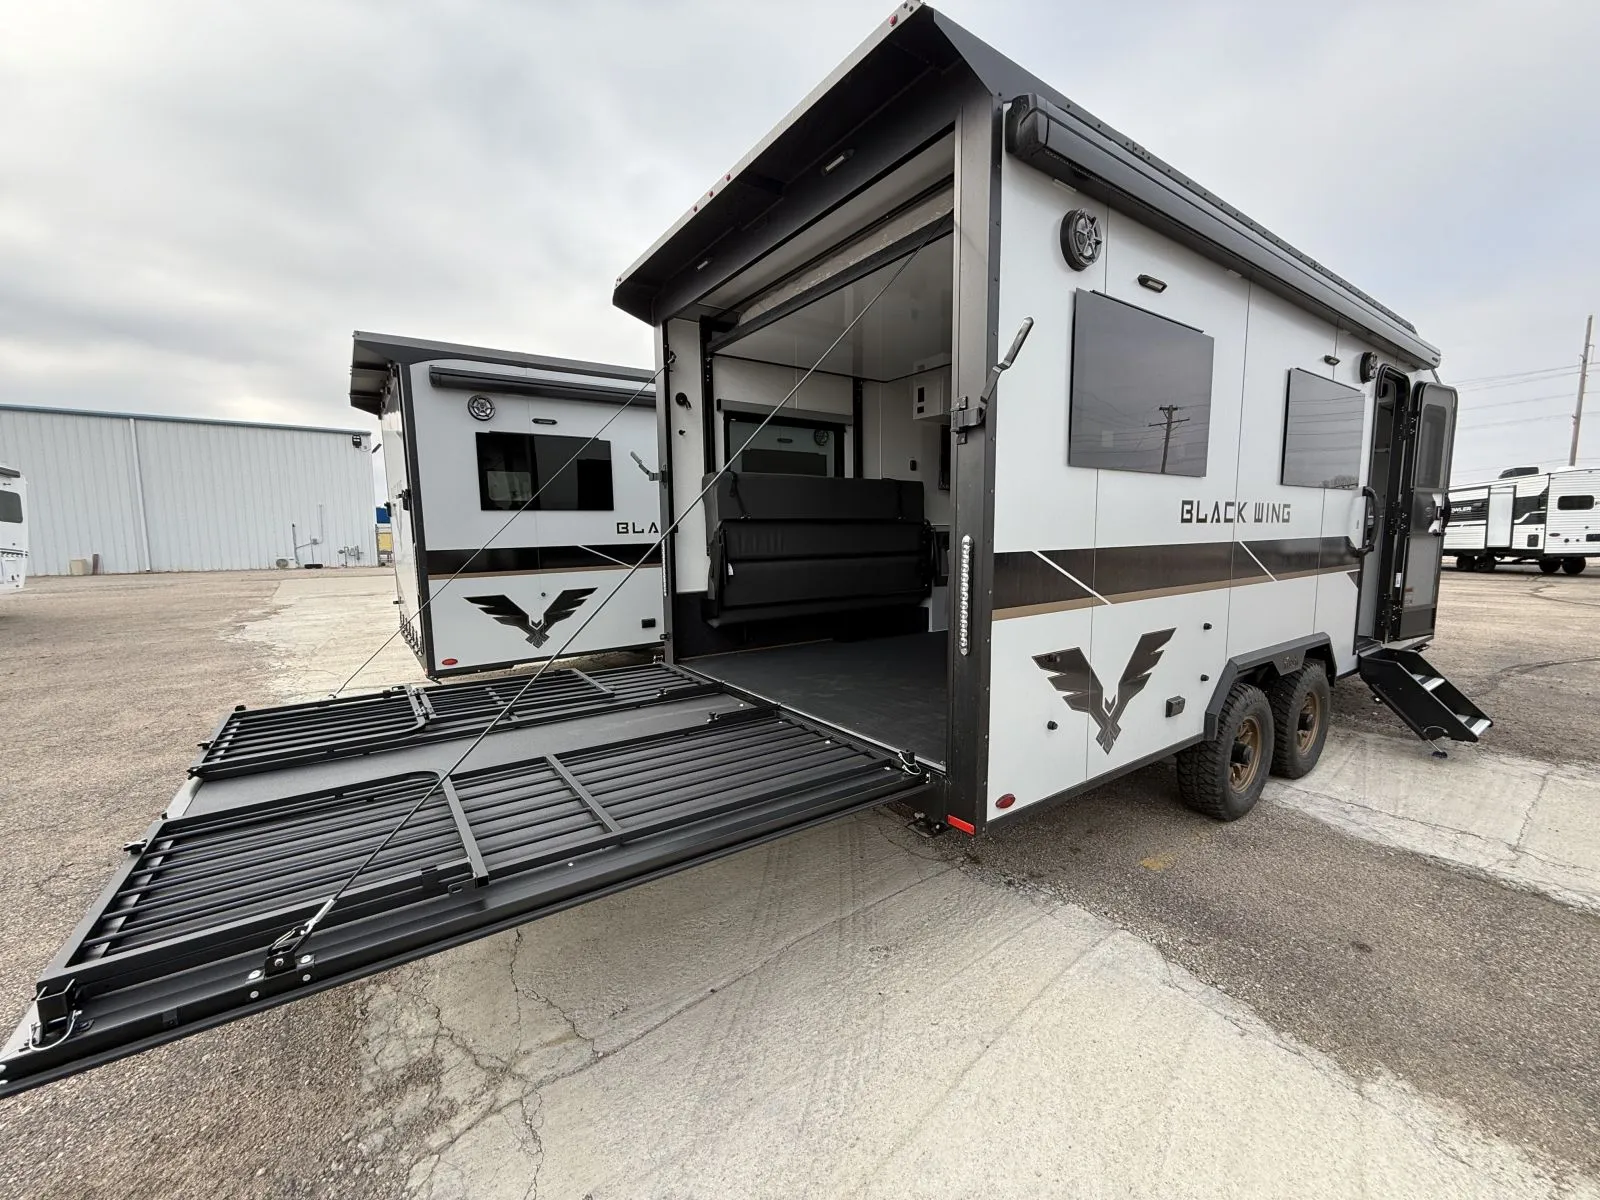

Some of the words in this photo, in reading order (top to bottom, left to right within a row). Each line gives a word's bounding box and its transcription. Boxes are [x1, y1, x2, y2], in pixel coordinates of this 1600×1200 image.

[1181, 500, 1248, 523] BLACK
[1254, 503, 1291, 523] WING
[616, 522, 660, 534] BLA
